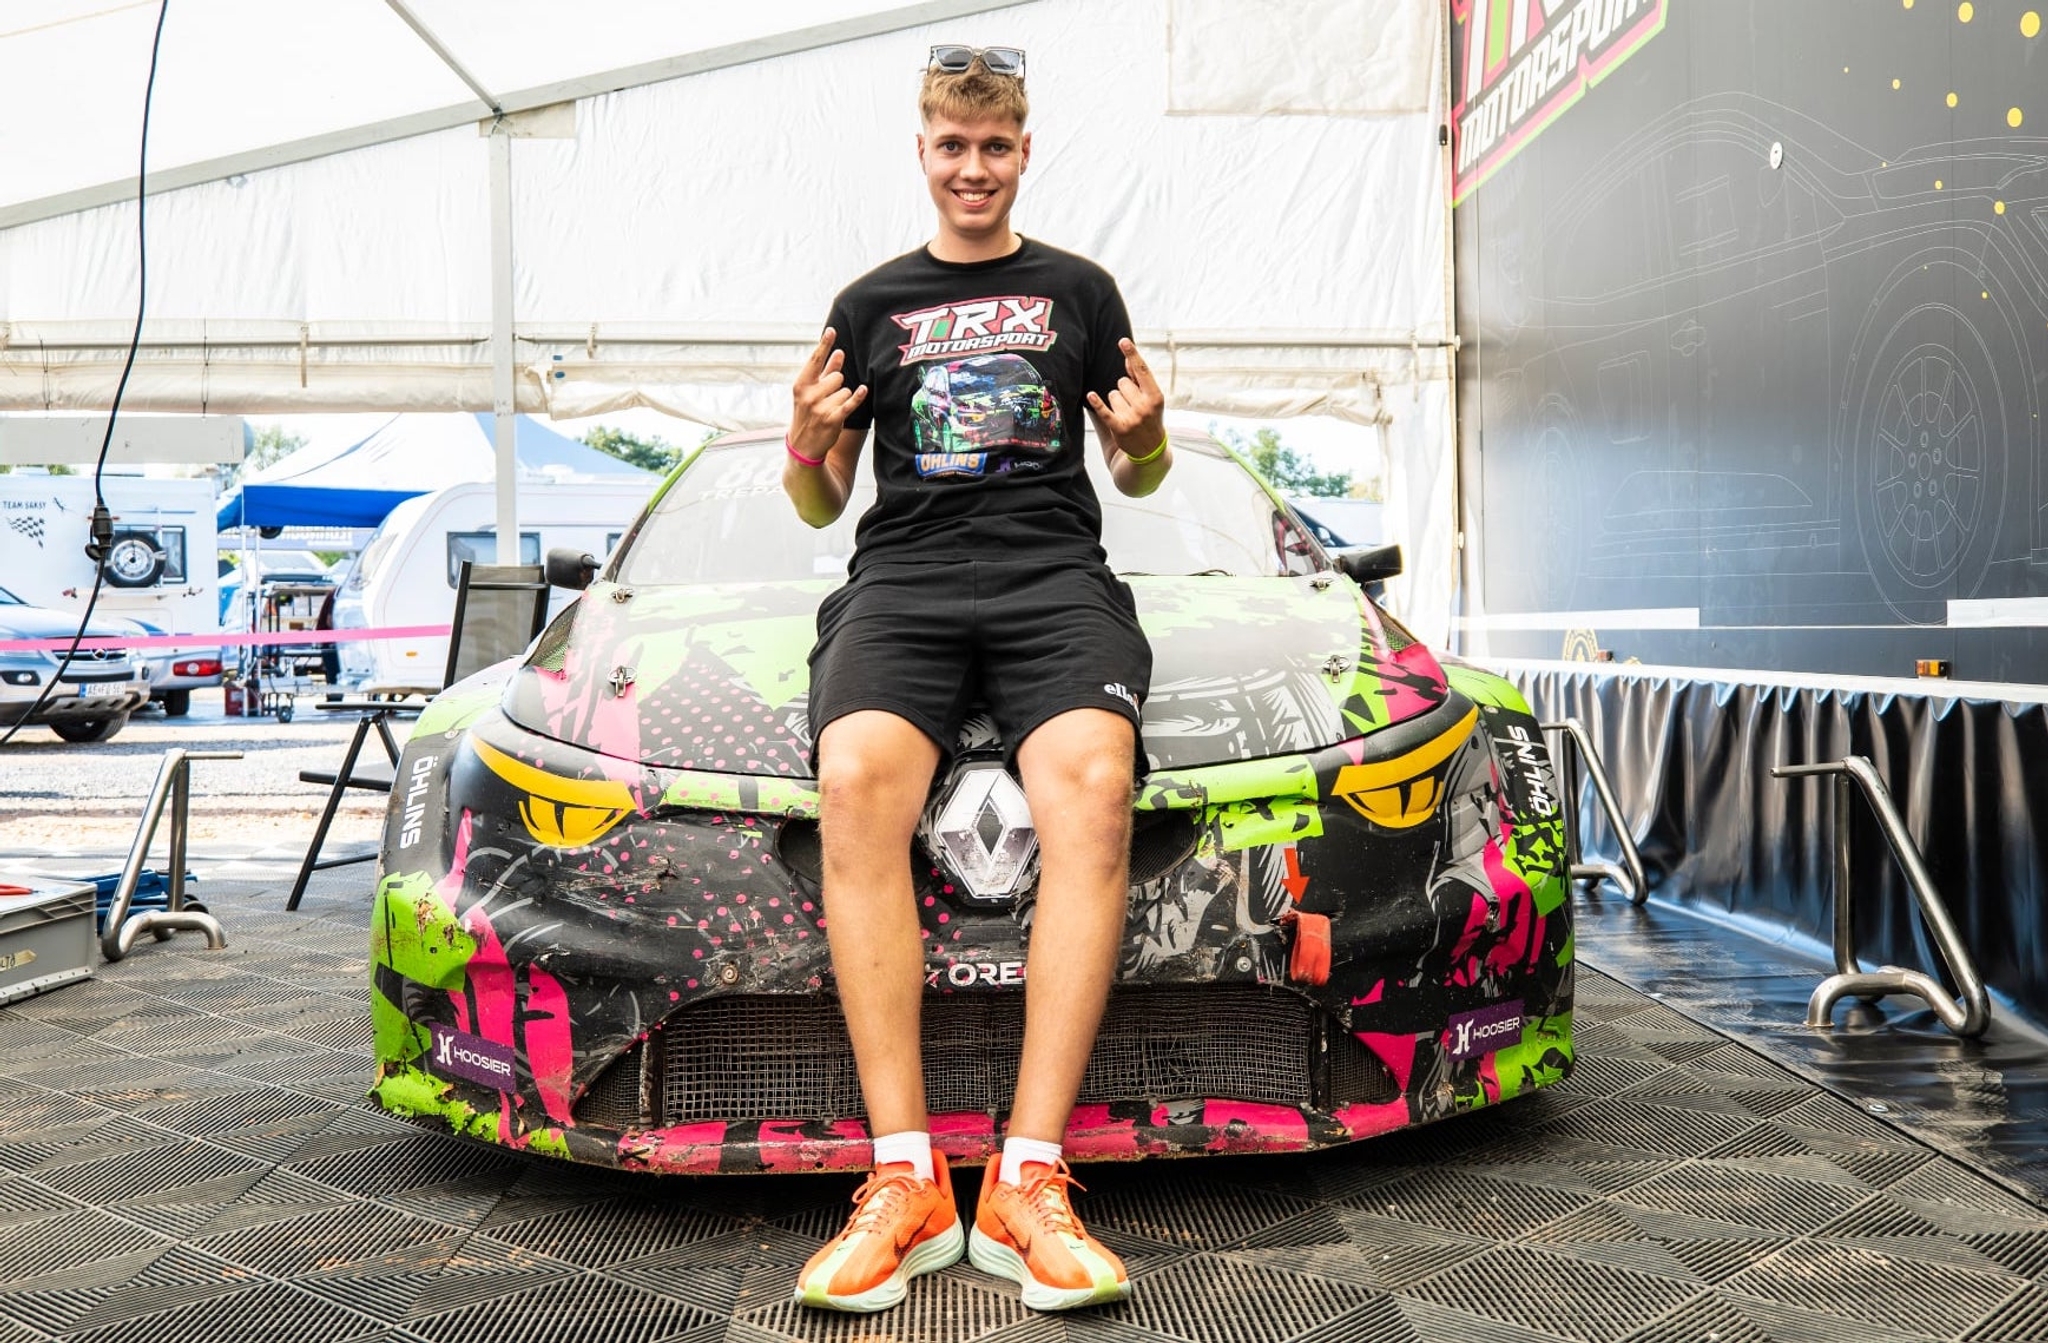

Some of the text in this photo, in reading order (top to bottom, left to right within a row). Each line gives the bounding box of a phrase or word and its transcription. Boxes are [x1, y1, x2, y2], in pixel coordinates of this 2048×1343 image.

[901, 300, 1046, 346] TRX
[907, 332, 1049, 359] MOTORSPORT
[3, 500, 23, 510] TEAM
[1507, 725, 1552, 816] ÖHLINS
[400, 755, 439, 849] ÖHLINS
[948, 961, 1027, 987] ORE
[1473, 1016, 1520, 1041] HOOSIER
[453, 1045, 511, 1077] HOOSIER
